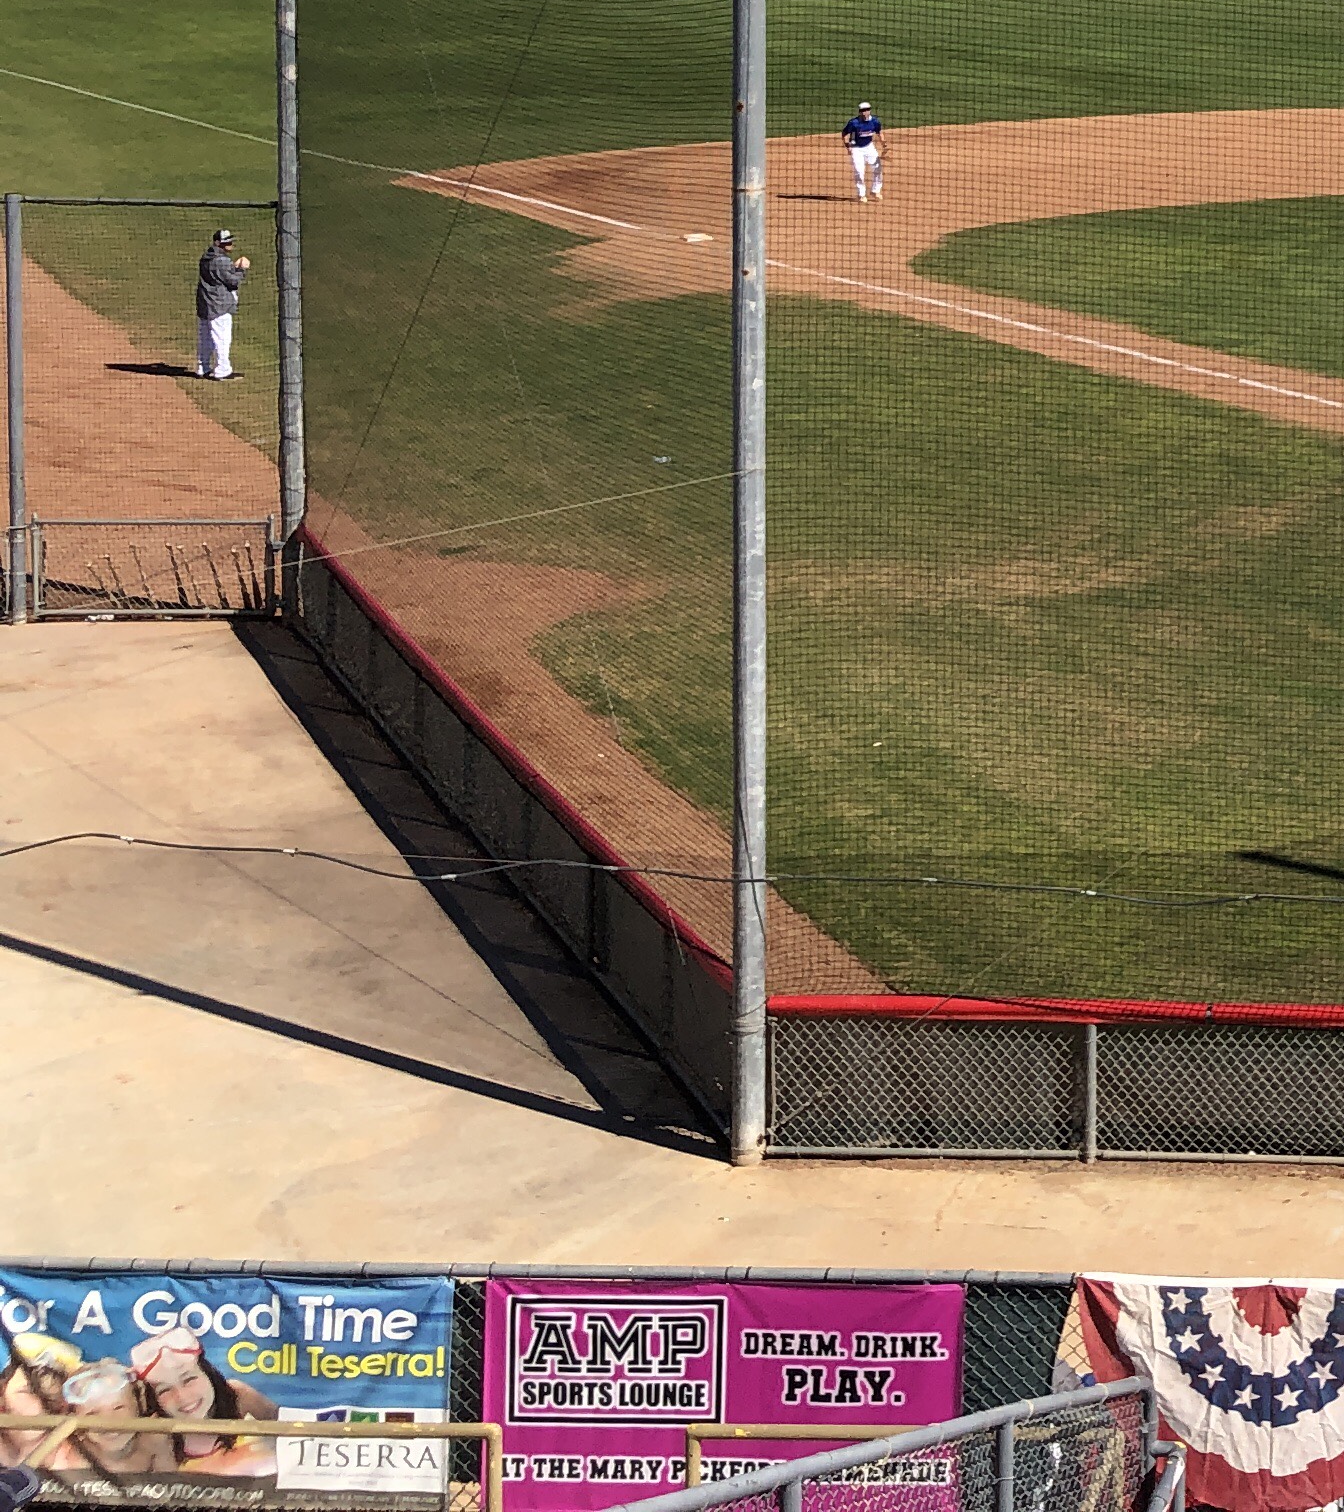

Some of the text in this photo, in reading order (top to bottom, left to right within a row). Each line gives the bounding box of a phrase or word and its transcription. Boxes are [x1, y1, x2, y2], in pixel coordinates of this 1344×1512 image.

[0, 1286, 418, 1342] or A Good Time
[227, 1341, 445, 1379] Call Teserra!
[522, 1313, 706, 1375] AMP
[742, 1331, 948, 1360] DREAM. DRINK.
[522, 1381, 706, 1409] SPORTS LOUNGE
[783, 1367, 904, 1405] PLAY.
[288, 1437, 439, 1469] TESERRA
[533, 1457, 663, 1480] THE MARY
